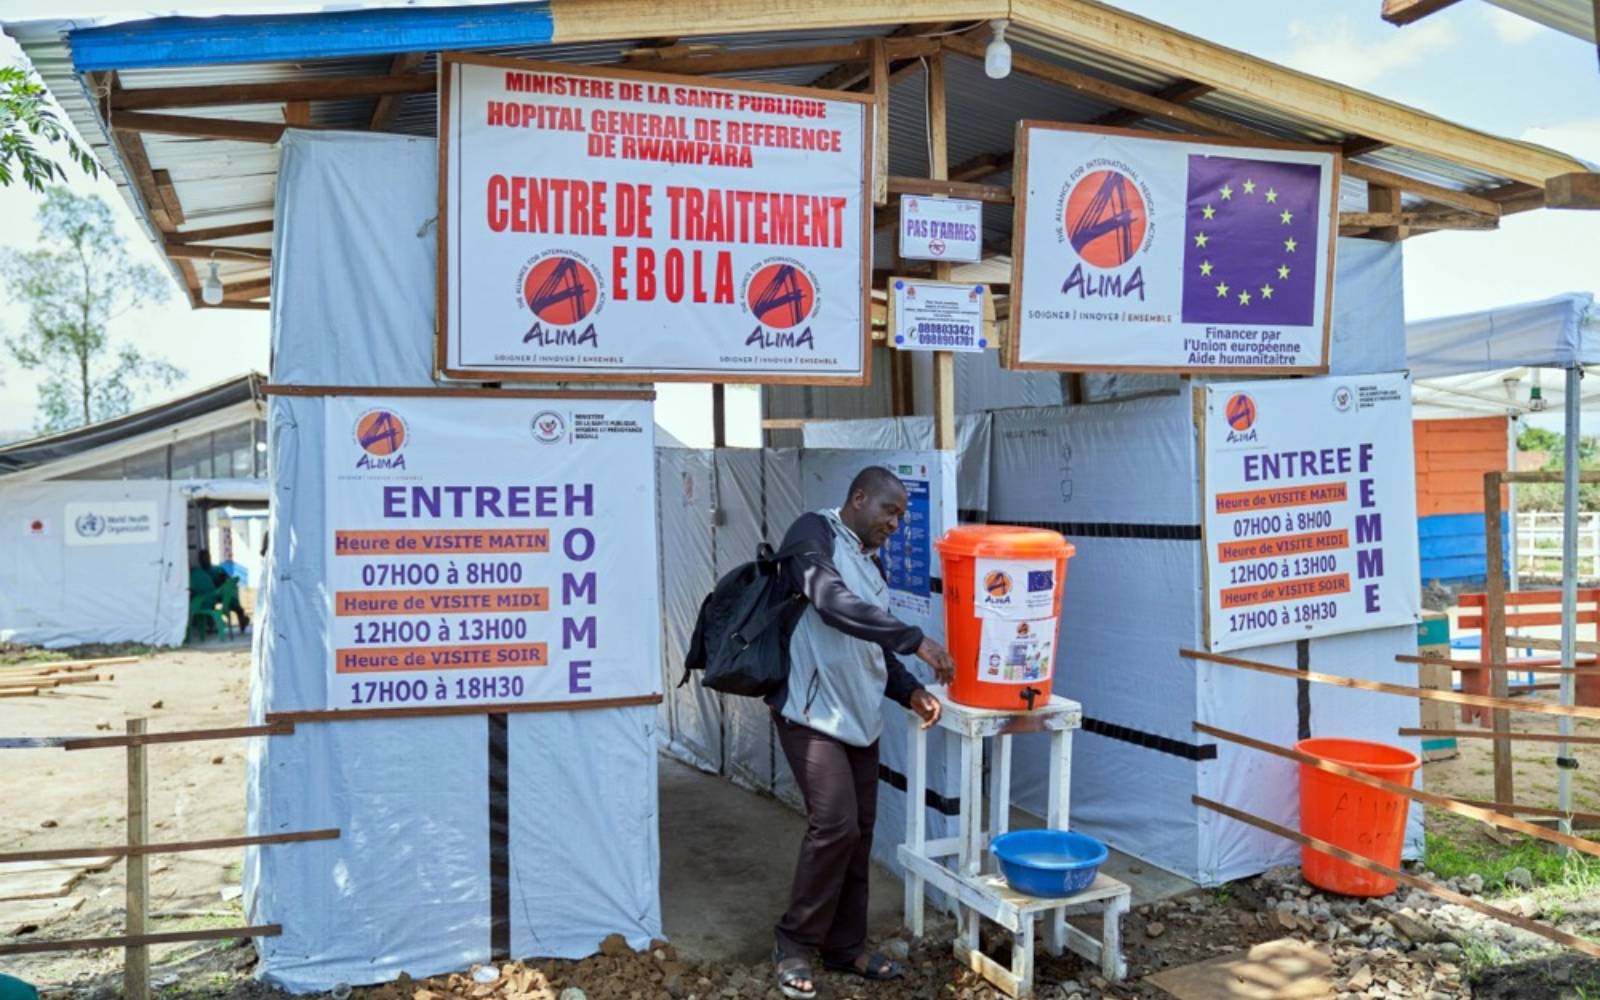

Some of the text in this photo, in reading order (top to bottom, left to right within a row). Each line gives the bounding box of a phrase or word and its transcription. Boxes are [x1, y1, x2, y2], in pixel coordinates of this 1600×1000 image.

[505, 72, 826, 119] MINISTERE DE LA SANTE PUBLIQUE
[487, 101, 842, 152] HOPITAL GENERAL DE REFERENCE
[588, 133, 753, 168] DE RWAMPARA
[487, 174, 847, 248] CENTRE DE TRAITEMENT
[907, 219, 976, 242] PAS D'ARMES
[612, 246, 735, 304] EBOLA
[1061, 262, 1144, 301] ALIMA
[1028, 310, 1070, 319] SOIGNER
[1079, 312, 1119, 321] INNOVER
[1127, 313, 1172, 323] ENSEMBLE
[522, 322, 598, 348] ALIMA
[745, 325, 814, 350] ALIMA
[1184, 338, 1300, 353] l'Union européenne
[1205, 327, 1281, 341] Financer par
[1188, 352, 1215, 364] Aide
[356, 453, 406, 470] ALIMA
[1244, 447, 1351, 482] ENTREE
[382, 485, 558, 518] ENTREE
[1216, 486, 1345, 510] Heure de VISITE MATIN
[1285, 512, 1293, 532] à
[1355, 442, 1384, 613] FEMME
[336, 535, 546, 550] Heure de VISITE MATIN
[1223, 534, 1343, 558] Heure de VISITE MIDI
[447, 561, 459, 585] à
[466, 562, 522, 584] 8H00
[1281, 558, 1289, 578] à
[561, 483, 597, 694] HOMME
[1225, 578, 1345, 604] Heure de VISITE SOIR
[344, 593, 540, 611] Heure de VISITE MIDI
[1282, 606, 1290, 625] à
[1294, 601, 1337, 623] 18H30
[438, 617, 450, 641] à
[459, 617, 526, 641] 13H00
[344, 648, 540, 668] Heure de VISITE SOIR
[435, 676, 447, 700] à
[455, 675, 524, 699] 18H30
